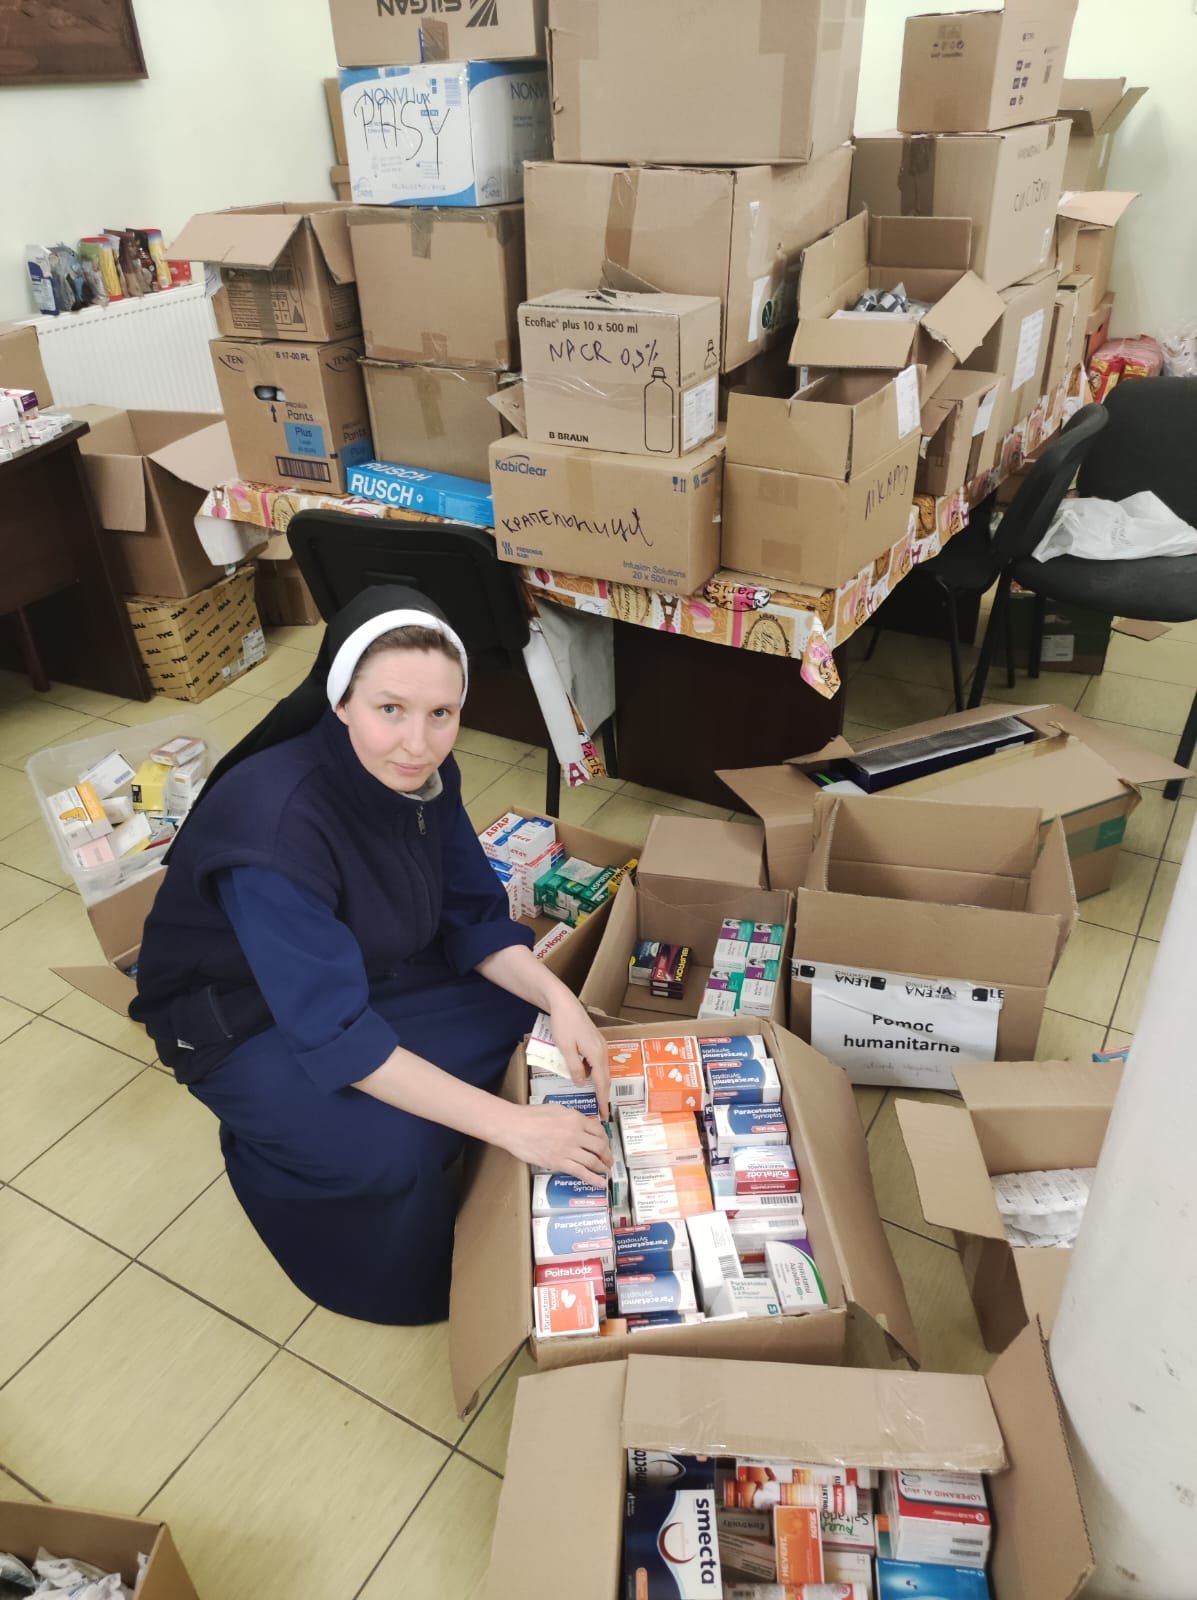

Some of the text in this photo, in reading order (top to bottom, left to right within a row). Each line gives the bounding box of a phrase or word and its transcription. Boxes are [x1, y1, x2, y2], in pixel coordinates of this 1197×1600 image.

[562, 320, 581, 332] plus
[583, 319, 595, 331] 10
[597, 323, 603, 332] x
[605, 321, 625, 334] 500
[626, 322, 638, 334] ml
[287, 410, 315, 423] Pants
[557, 432, 589, 443] BRAUN
[360, 462, 432, 482] RUSCH
[495, 458, 547, 478] KabiClear
[351, 473, 415, 506] RUSCH
[623, 560, 687, 579] Infusion Solutions
[632, 570, 644, 580] 20
[650, 573, 668, 584] 500
[668, 575, 679, 586] ml
[486, 817, 510, 837] APAP
[536, 929, 568, 960] po-Napro
[675, 947, 690, 982] IBUPROM
[834, 975, 870, 988] LENA
[872, 1014, 934, 1033] Pomoc
[843, 1034, 961, 1053] humanitarna
[733, 1107, 781, 1116] Paracetamol
[554, 1218, 607, 1229] Paracetamol
[631, 1450, 648, 1482] mecta
[695, 1497, 717, 1585] smecta
